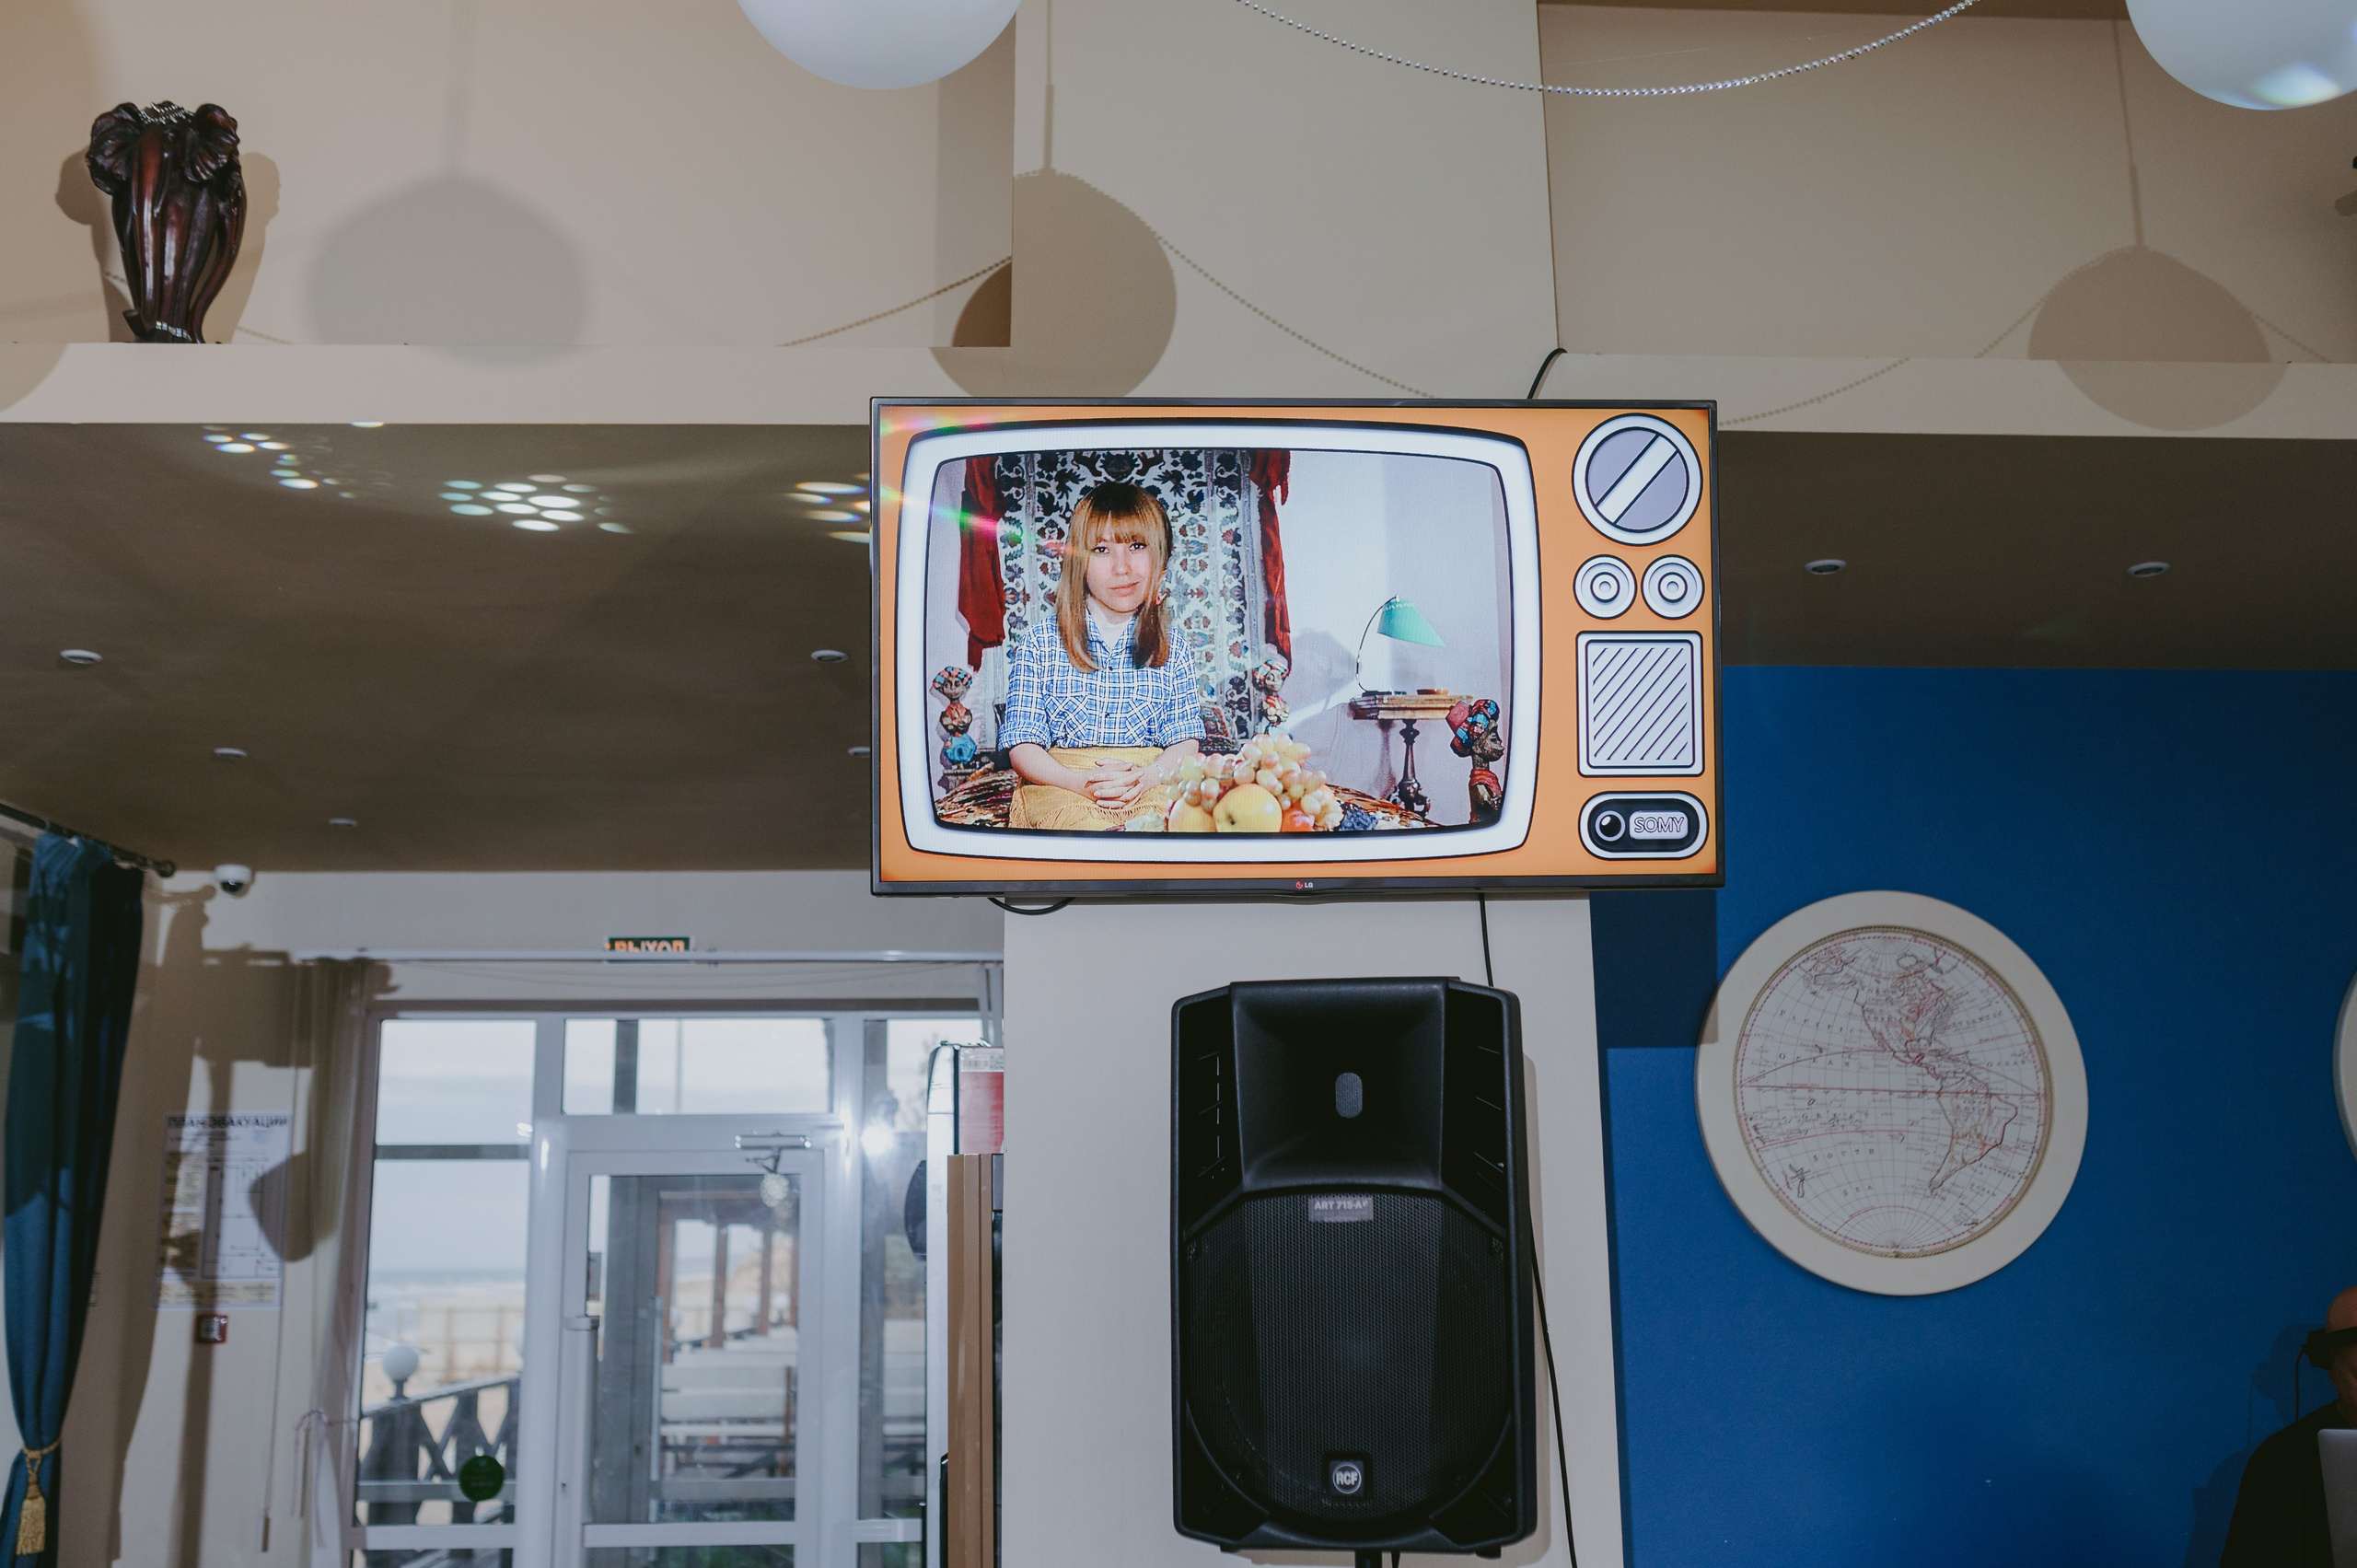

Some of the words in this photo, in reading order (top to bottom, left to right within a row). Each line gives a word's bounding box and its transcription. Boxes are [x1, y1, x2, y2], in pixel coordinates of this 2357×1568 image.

[1634, 816, 1685, 833] SOMY
[1314, 1201, 1334, 1210] ART
[1336, 1470, 1358, 1485] RCF
